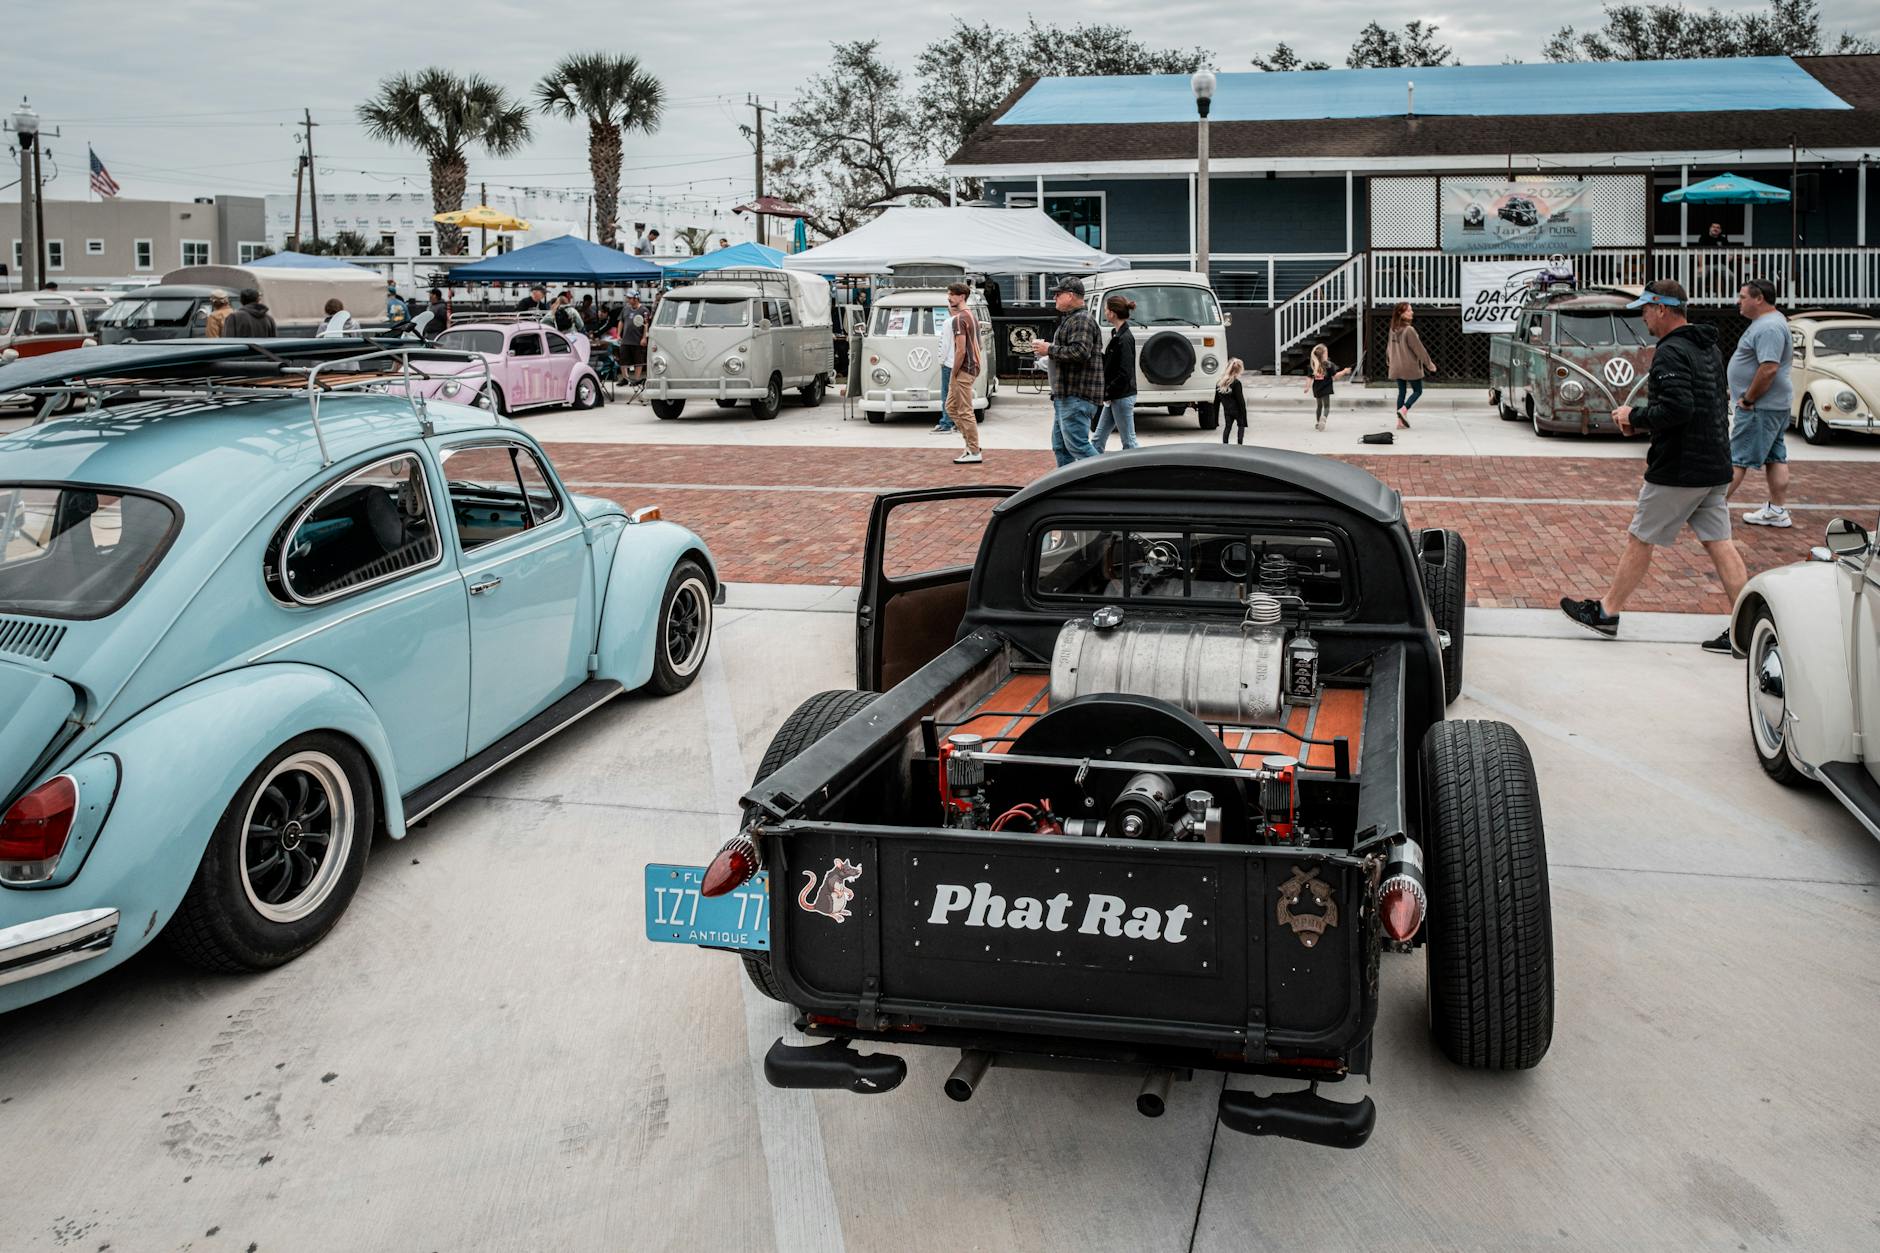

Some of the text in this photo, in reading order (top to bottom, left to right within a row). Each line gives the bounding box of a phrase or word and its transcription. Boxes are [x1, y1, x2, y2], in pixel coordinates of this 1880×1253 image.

[1527, 187, 1577, 198] 2023
[1476, 286, 1530, 304] DAVI
[1463, 305, 1522, 322] CUSTO
[1604, 357, 1634, 387] VW
[733, 892, 770, 932] 77
[927, 882, 1193, 943] Phat Rat
[689, 930, 749, 944] ANTIQUE
